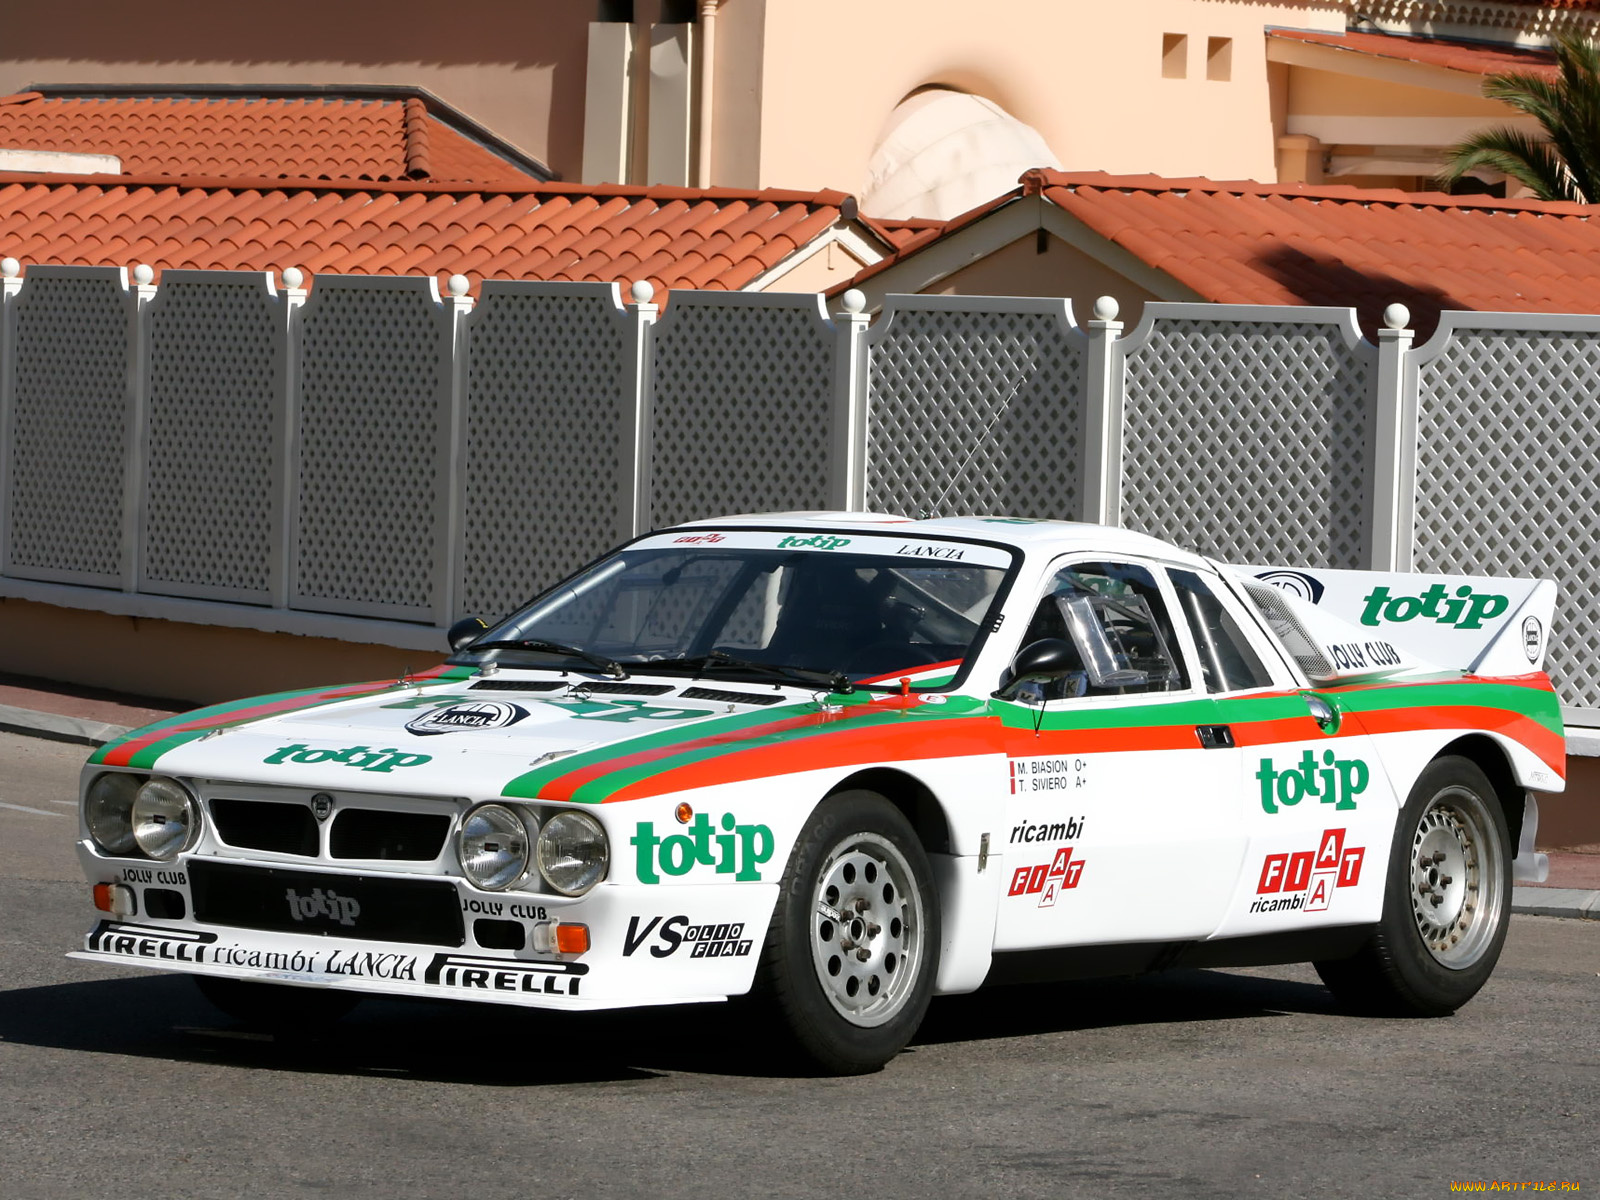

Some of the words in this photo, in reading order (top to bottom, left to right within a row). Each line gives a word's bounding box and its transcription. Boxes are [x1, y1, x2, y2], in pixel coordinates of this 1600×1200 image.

[777, 535, 851, 551] totip
[896, 545, 965, 560] LANCIA
[1360, 584, 1509, 629] totip
[1327, 643, 1366, 671] JOLLY
[1364, 641, 1402, 664] CLUB
[439, 713, 488, 727] LANCIA
[263, 744, 432, 773] totip
[1018, 763, 1028, 774] M.
[1031, 760, 1068, 774] BIASION
[1019, 779, 1027, 792] T.
[1032, 777, 1067, 791] SIVIERO
[1075, 776, 1087, 788] A+
[1256, 749, 1369, 814] totip
[1010, 816, 1085, 843] ricambi
[630, 812, 775, 884] totip
[123, 868, 154, 884] JOLLY
[157, 871, 187, 885] CLUB
[286, 887, 361, 926] totip
[463, 899, 503, 915] JOLLY
[510, 905, 547, 919] CLUB
[1250, 893, 1306, 914] ricambi
[622, 915, 689, 958] VS
[683, 923, 745, 941] OLIO
[89, 920, 218, 962] PIRELLI
[213, 944, 319, 973] ricambi
[324, 949, 417, 981] LANCIA
[425, 953, 589, 995] PIRELLI
[691, 940, 752, 958] FIAT
